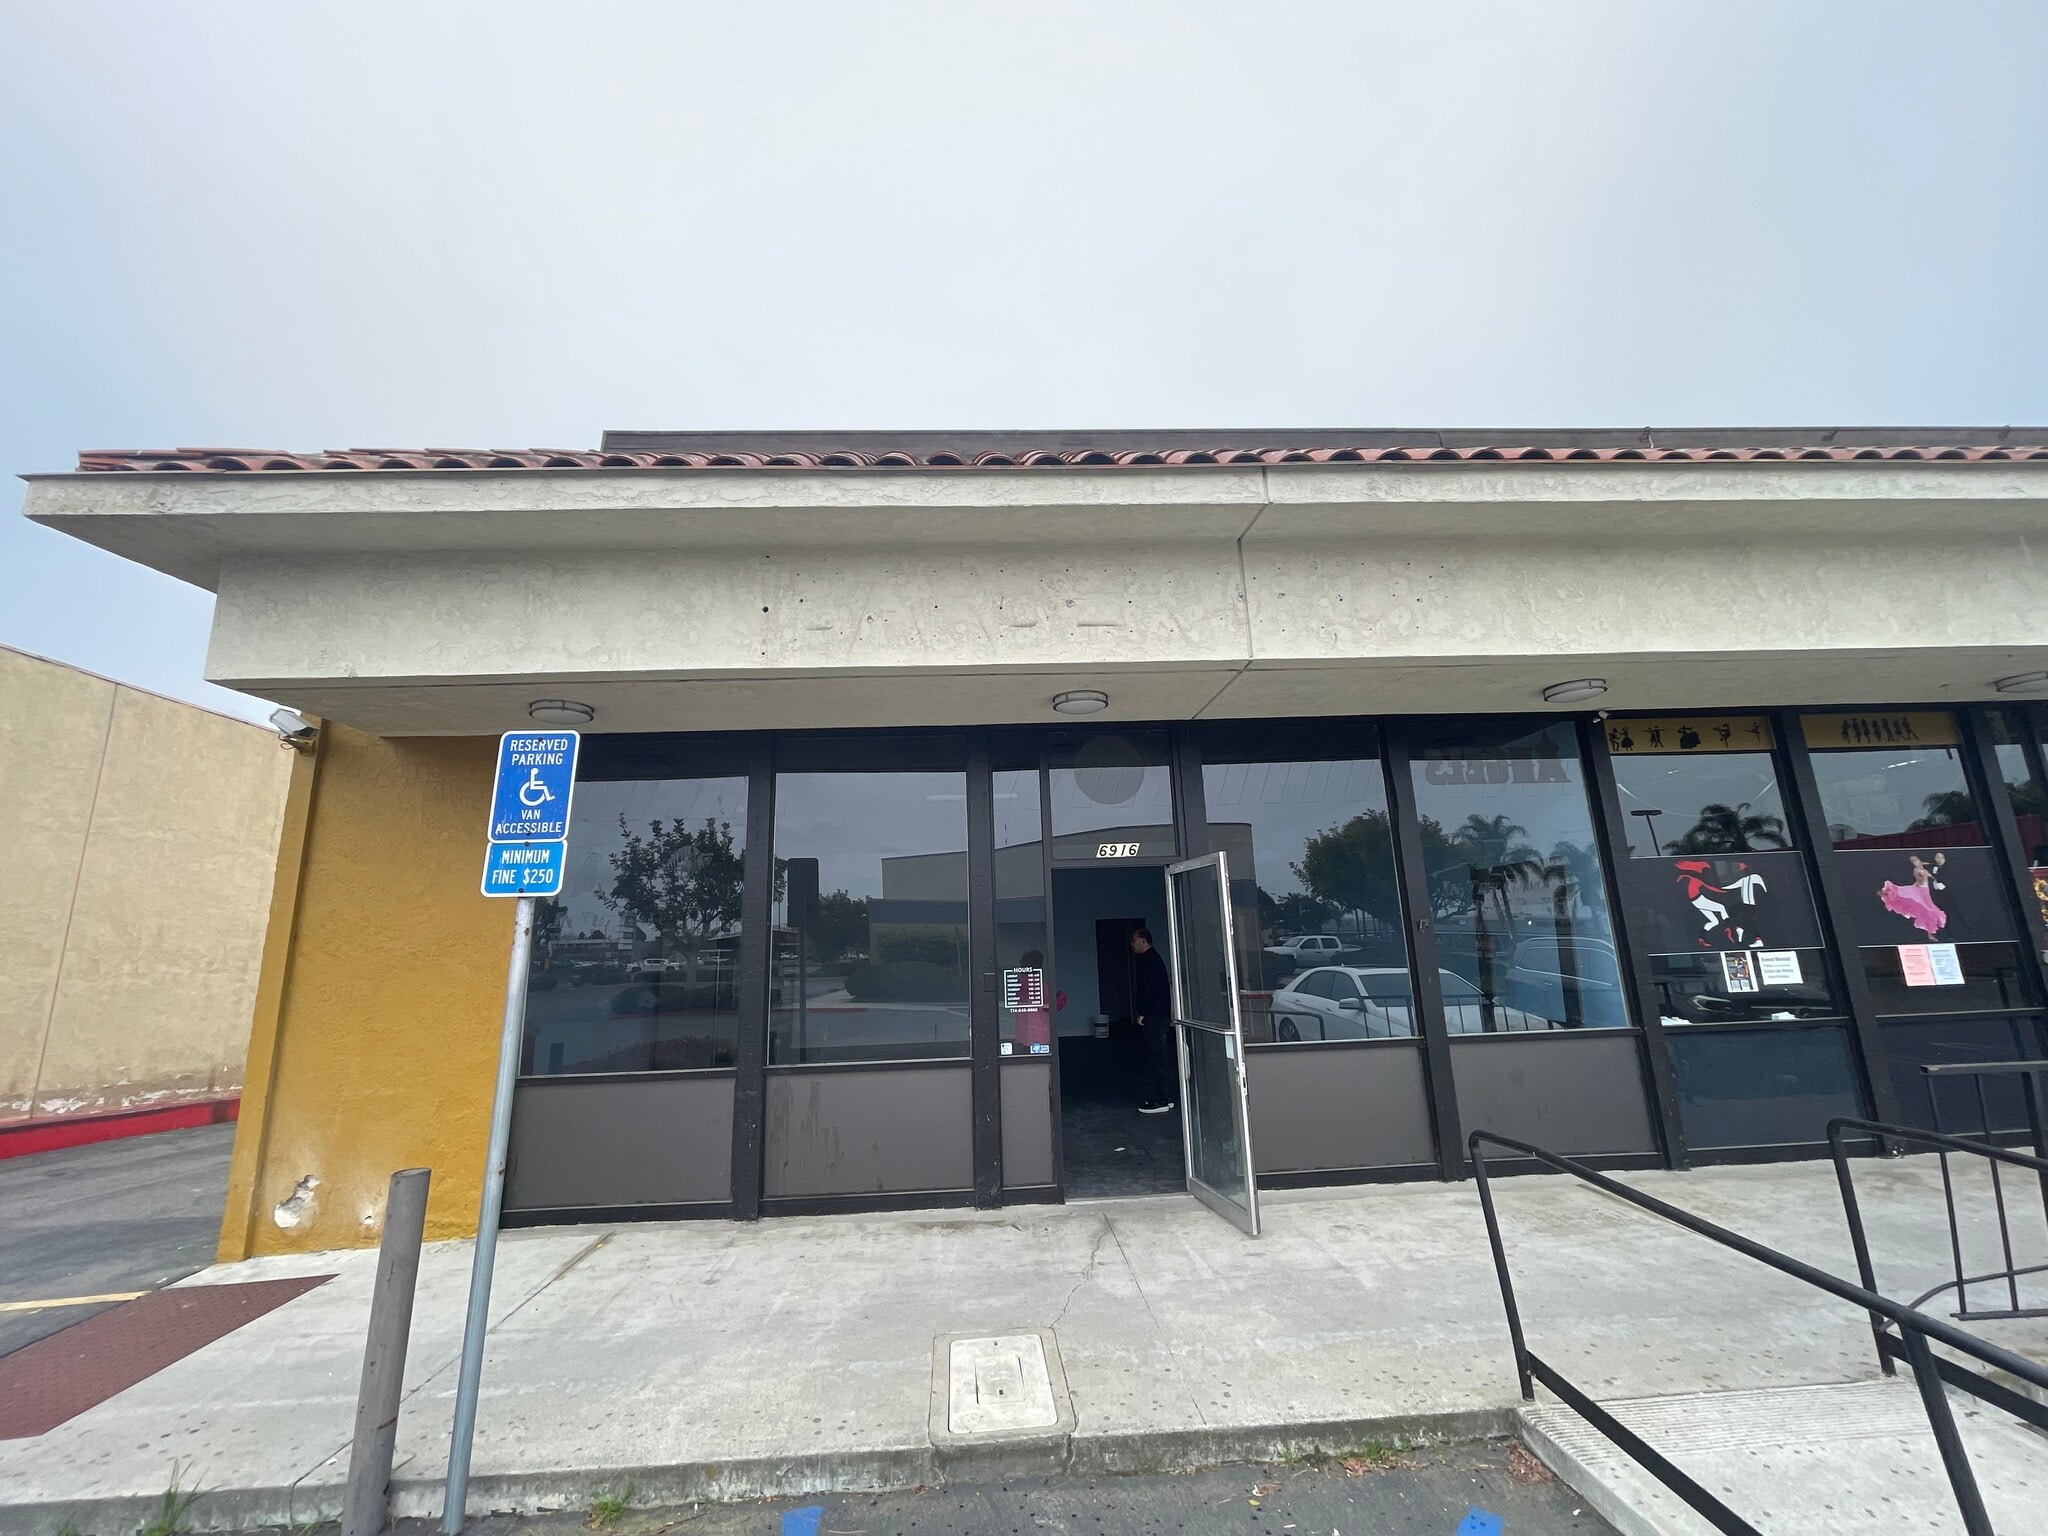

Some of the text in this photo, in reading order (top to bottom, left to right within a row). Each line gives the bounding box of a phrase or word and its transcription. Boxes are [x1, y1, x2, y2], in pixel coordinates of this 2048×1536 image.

[510, 739, 568, 751] RESERVED
[511, 753, 564, 765] PARKING
[521, 809, 541, 820] VAN
[495, 821, 563, 834] ACCESSIBLE
[501, 849, 550, 865] MINIMUM
[1100, 844, 1138, 857] 6916
[491, 868, 554, 886] FINE $250
